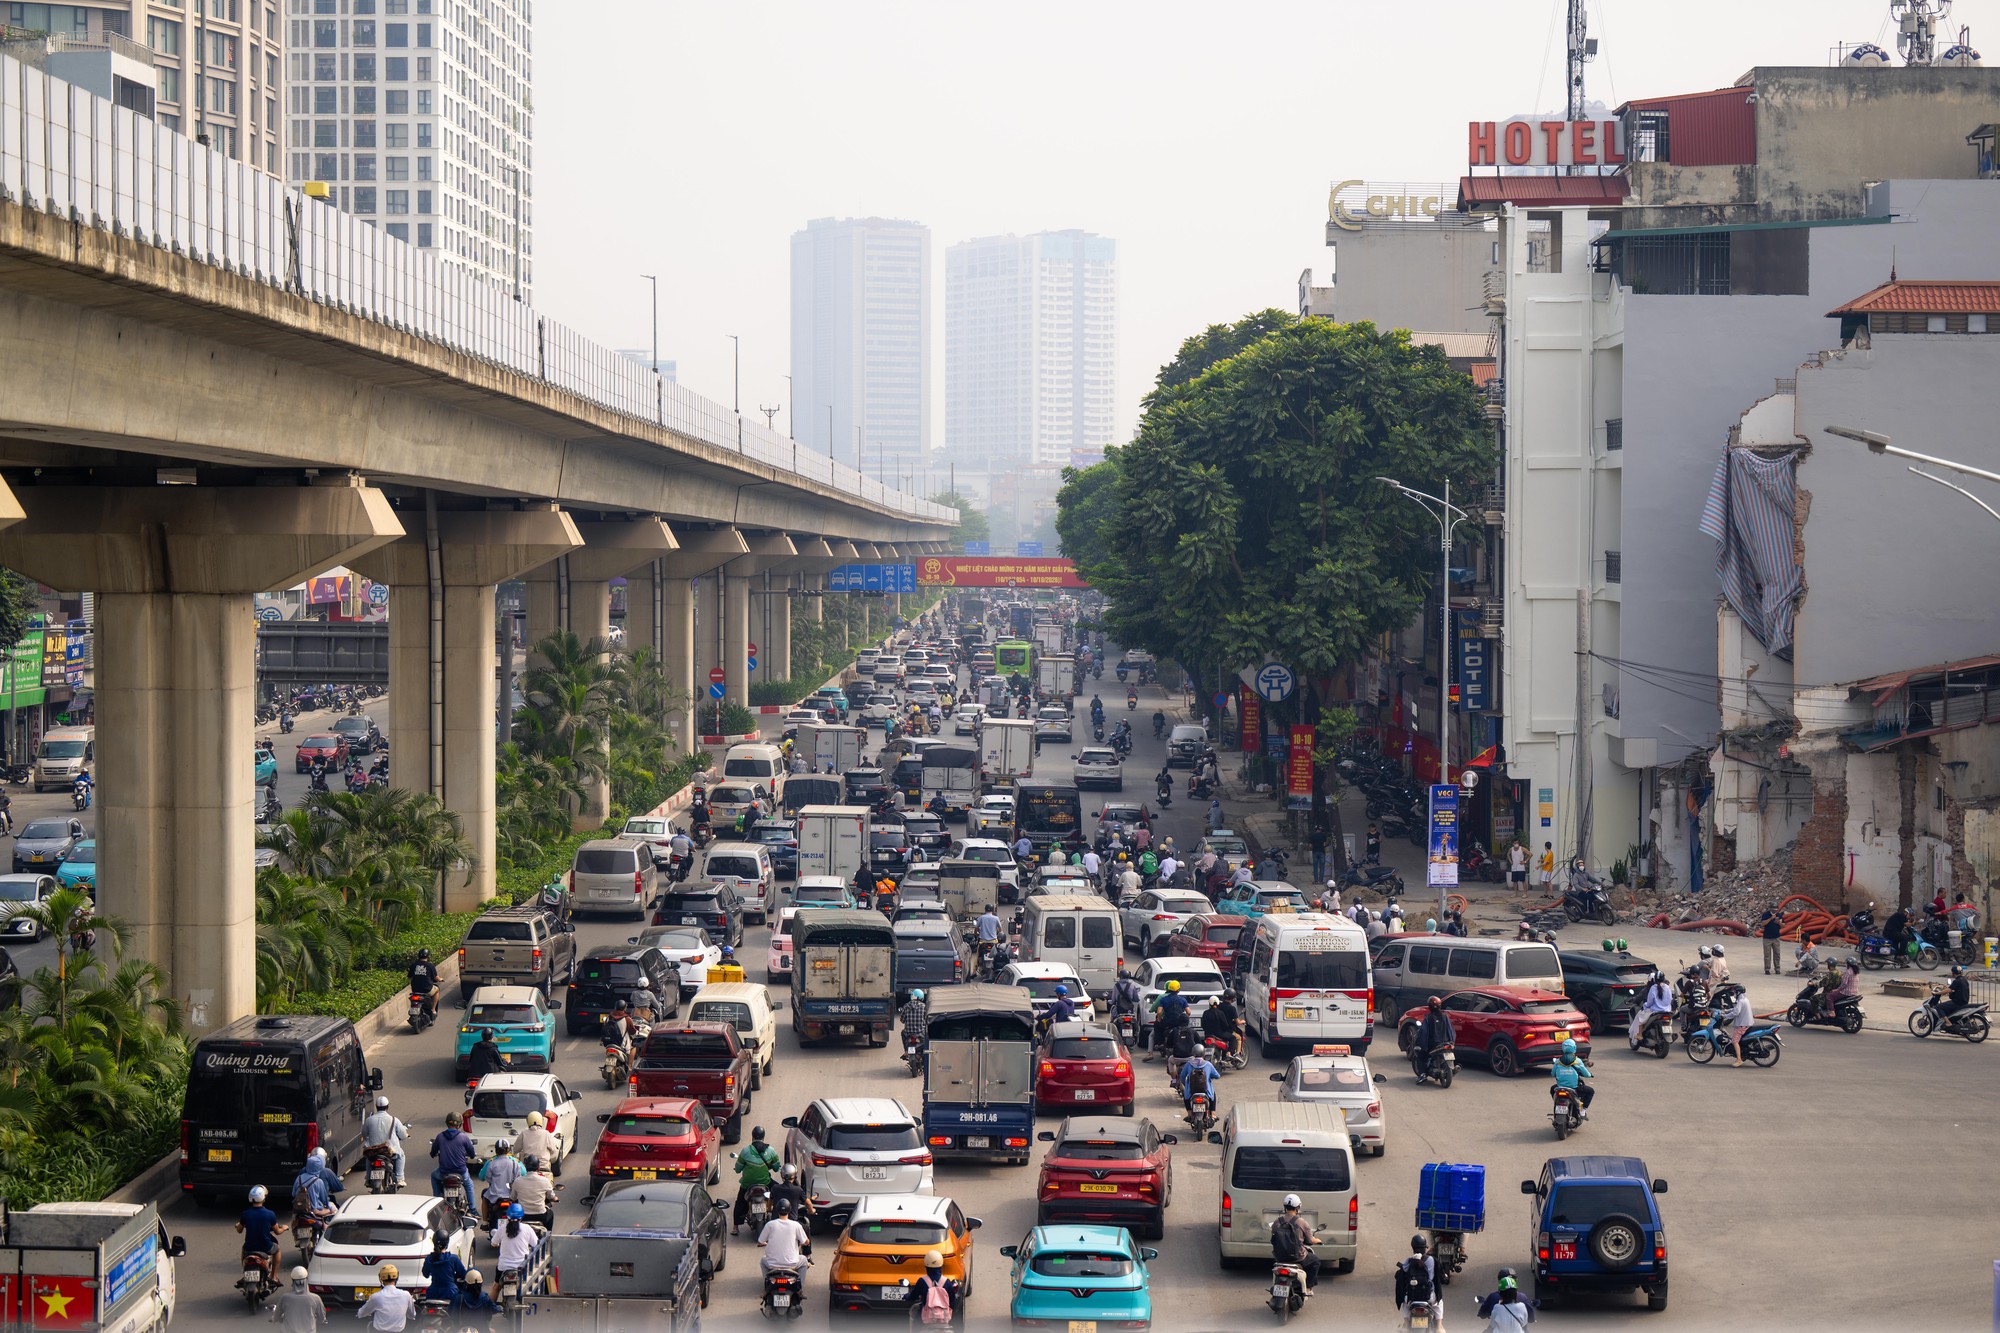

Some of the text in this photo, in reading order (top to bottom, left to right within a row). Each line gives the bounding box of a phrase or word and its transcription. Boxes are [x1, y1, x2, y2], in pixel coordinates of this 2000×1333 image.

[1469, 121, 1625, 165] HOTEL
[1366, 196, 1438, 216] CHIC
[956, 564, 972, 574] NHIỆT
[972, 564, 983, 574] LIỆT
[984, 564, 998, 573] CHÀO
[1015, 565, 1023, 573] 72
[1023, 564, 1037, 573] NĂM
[1037, 564, 1051, 573] NGÀY
[1464, 642, 1483, 709] HOTEL
[1320, 938, 1350, 946] PHONG
[206, 1053, 289, 1068] Quảng Đông
[959, 1112, 998, 1122] 29H-081.46
[1555, 1251, 1574, 1259] 11-79
